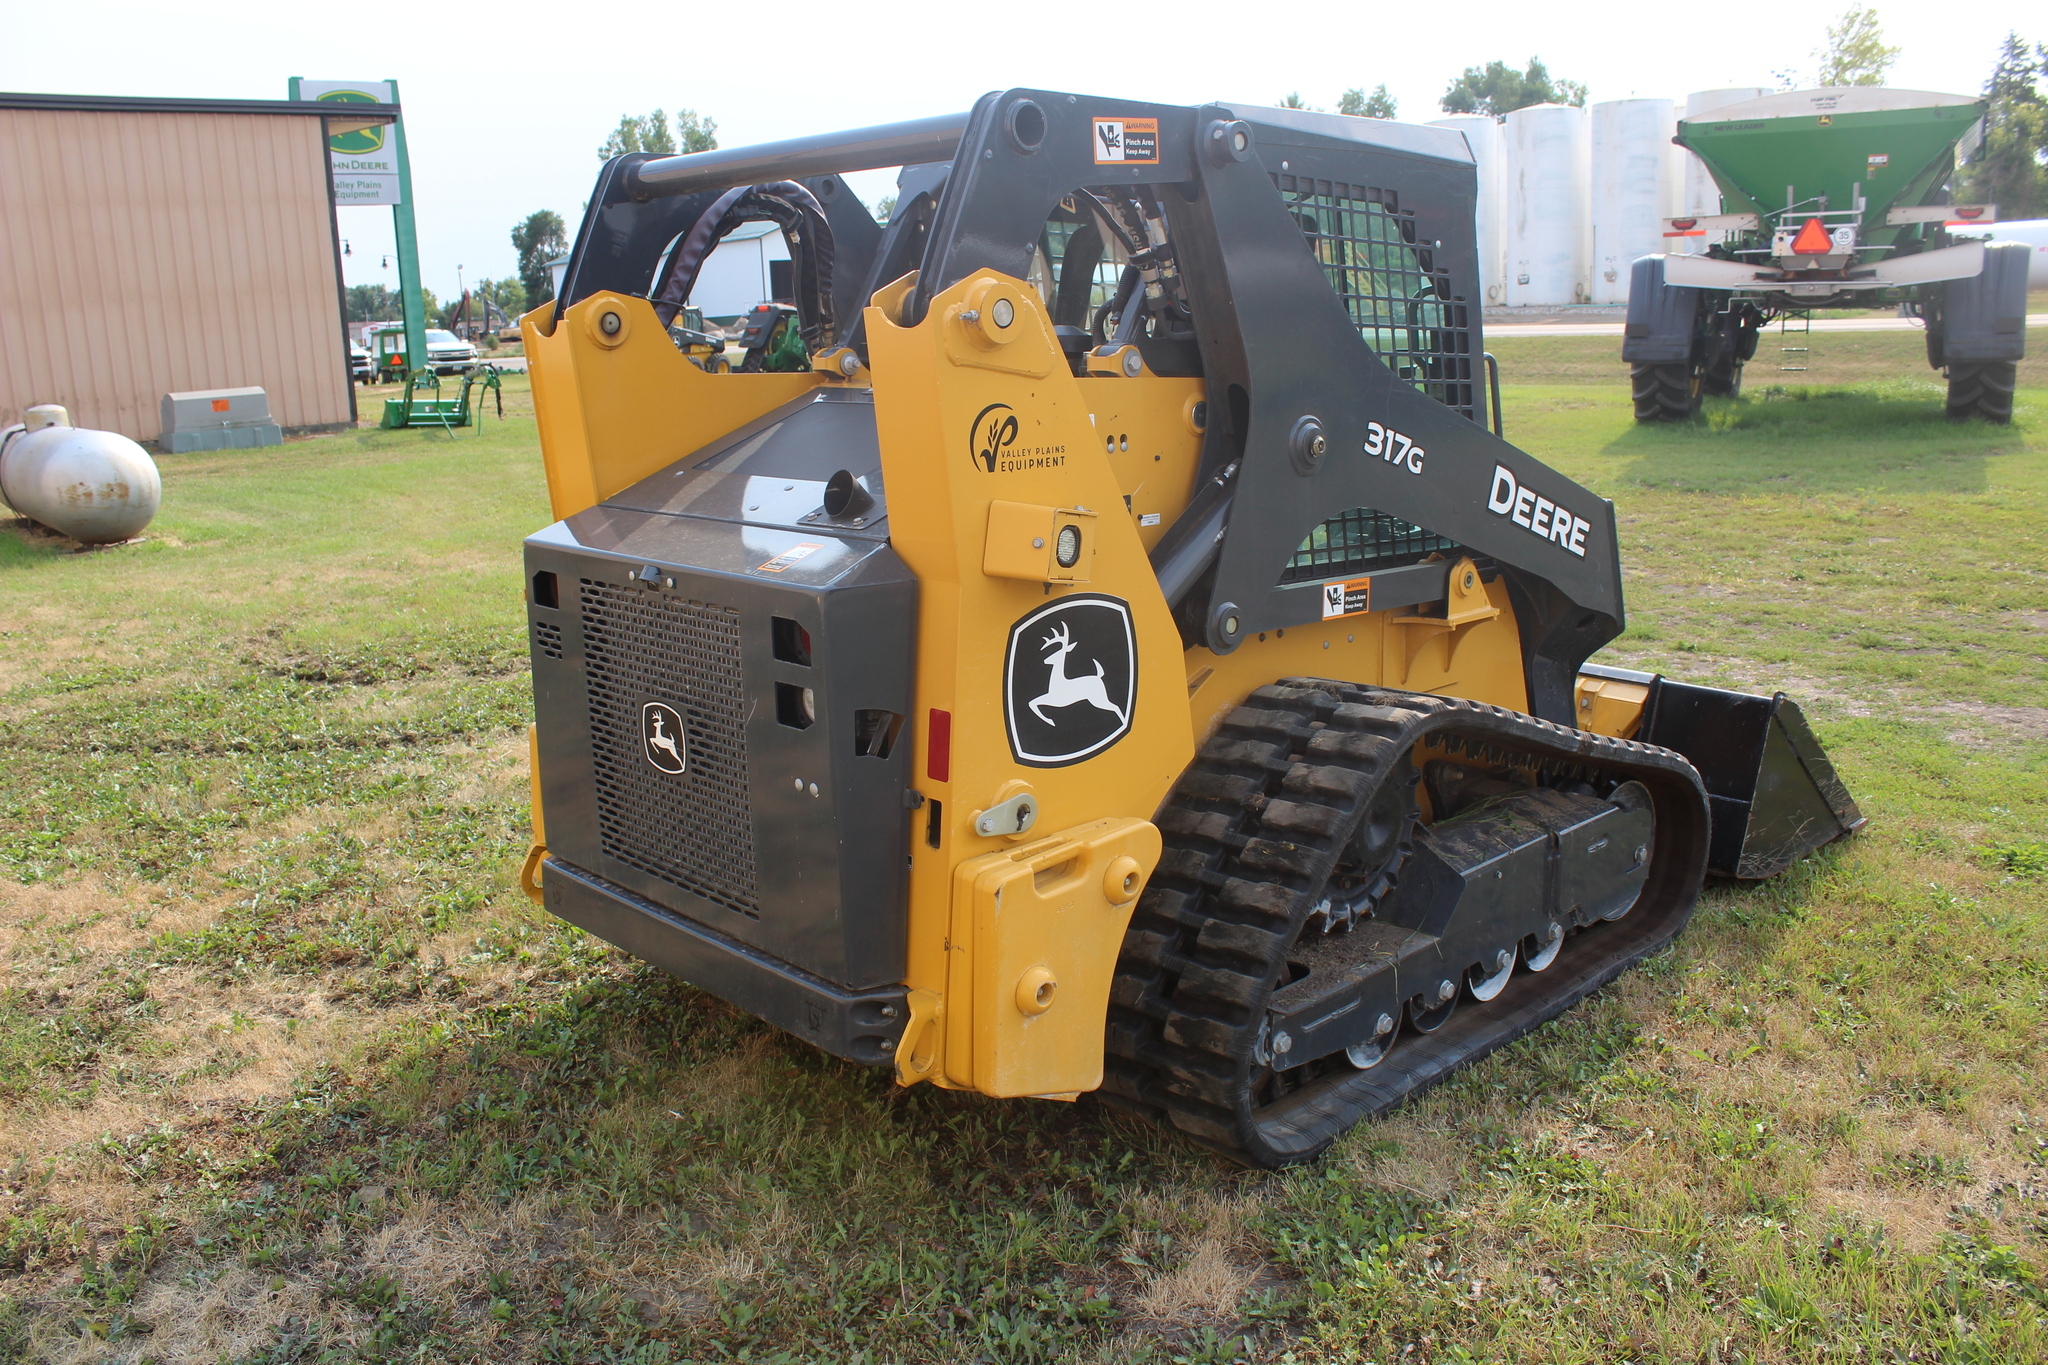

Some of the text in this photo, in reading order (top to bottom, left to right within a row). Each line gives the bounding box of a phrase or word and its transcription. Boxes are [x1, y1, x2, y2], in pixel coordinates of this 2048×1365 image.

[1126, 138, 1141, 146] Pinch
[1126, 148, 1138, 156] Keep
[351, 160, 389, 170] DEERE
[334, 180, 382, 190] alley Plains
[335, 190, 379, 199] Equipment
[1838, 231, 1850, 240] 35
[1001, 445, 1066, 458] VALLEY PLAINS
[1363, 421, 1426, 475] 317G
[1001, 456, 1066, 473] EQUIPMENT
[1487, 463, 1591, 558] DEERE
